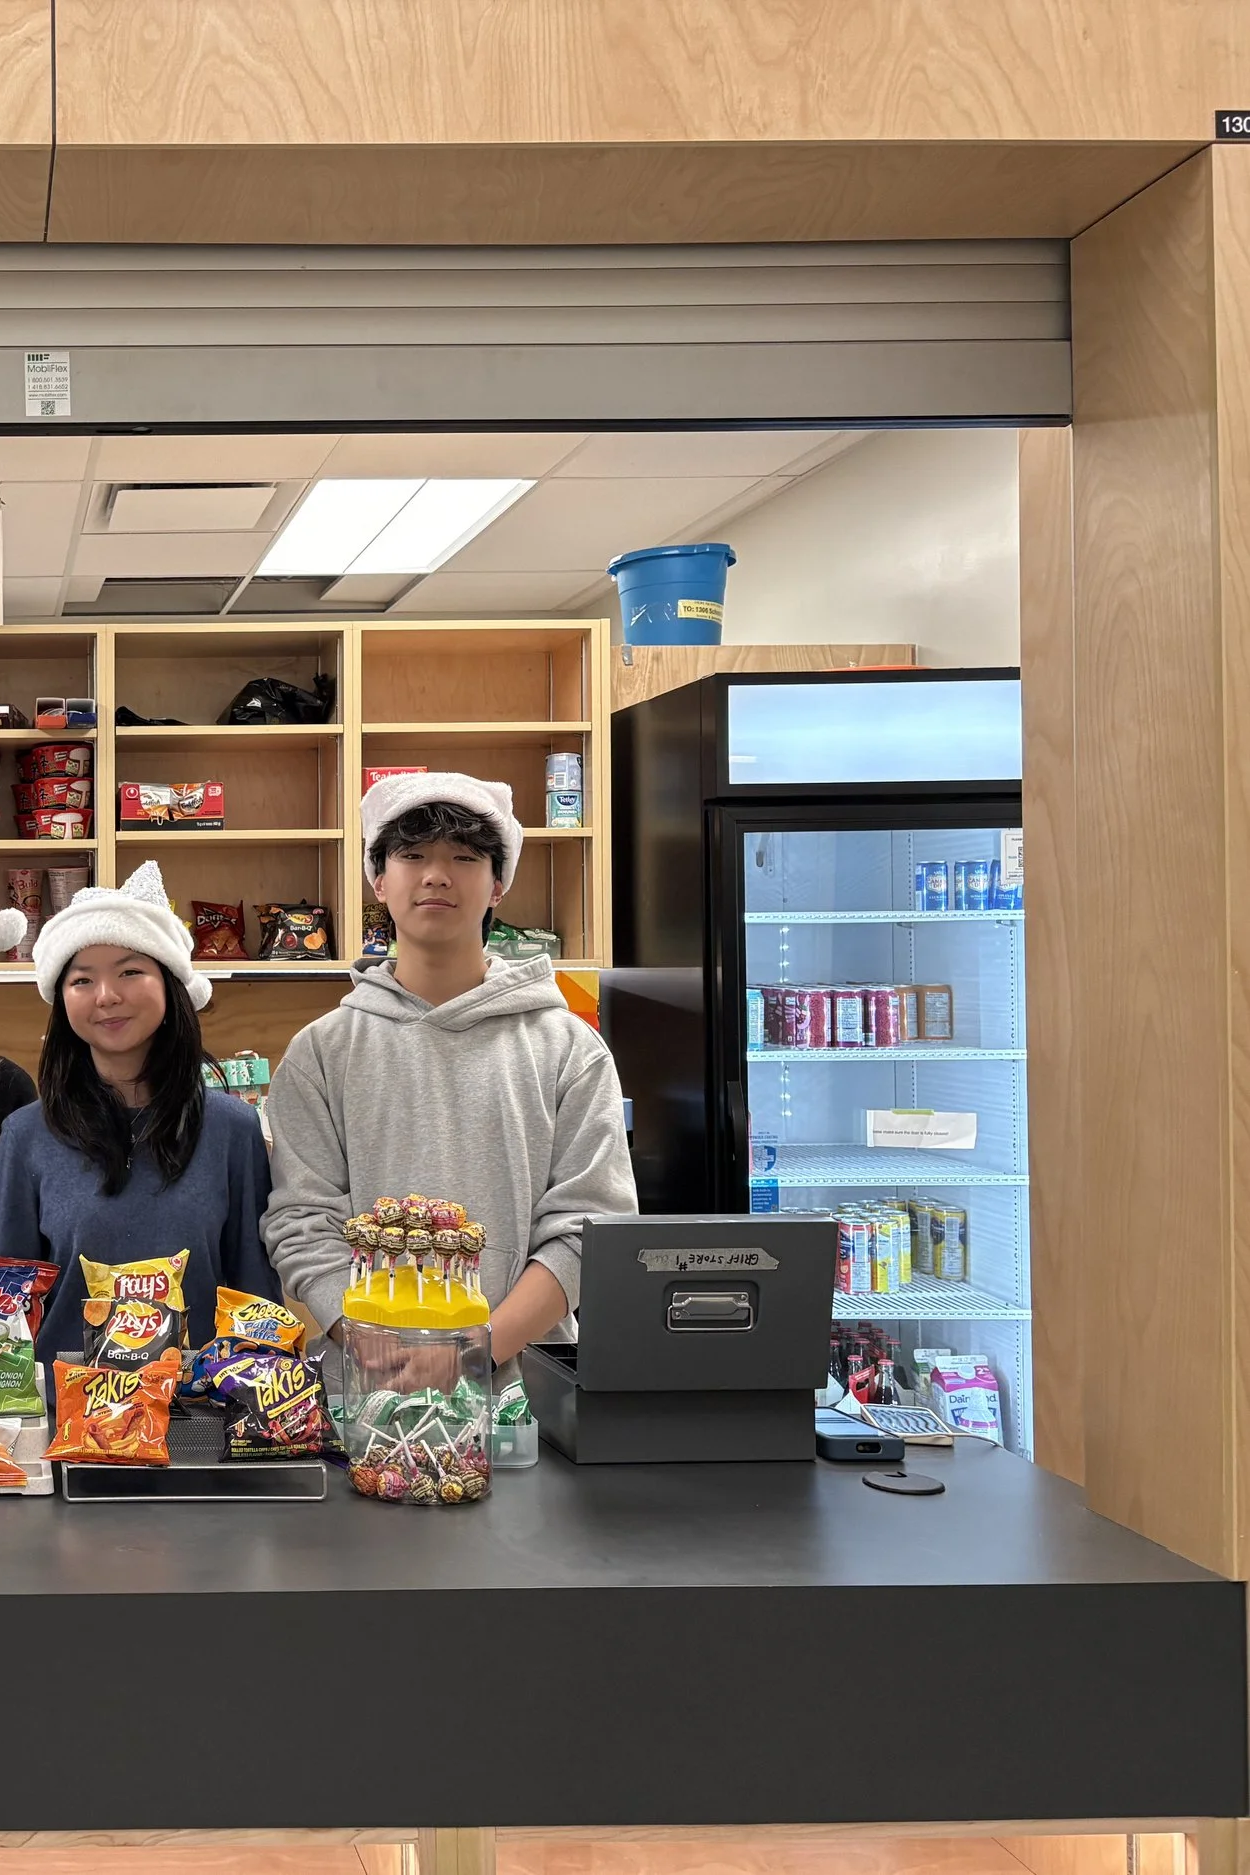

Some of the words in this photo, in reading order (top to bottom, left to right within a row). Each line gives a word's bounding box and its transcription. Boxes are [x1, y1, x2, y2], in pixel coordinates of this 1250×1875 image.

[558, 796, 576, 804] Tetley
[688, 1253, 724, 1265] STORE
[727, 1254, 759, 1266] GRIFF
[107, 1349, 149, 1360] Bar-B-Q
[0, 1372, 24, 1380] ONION
